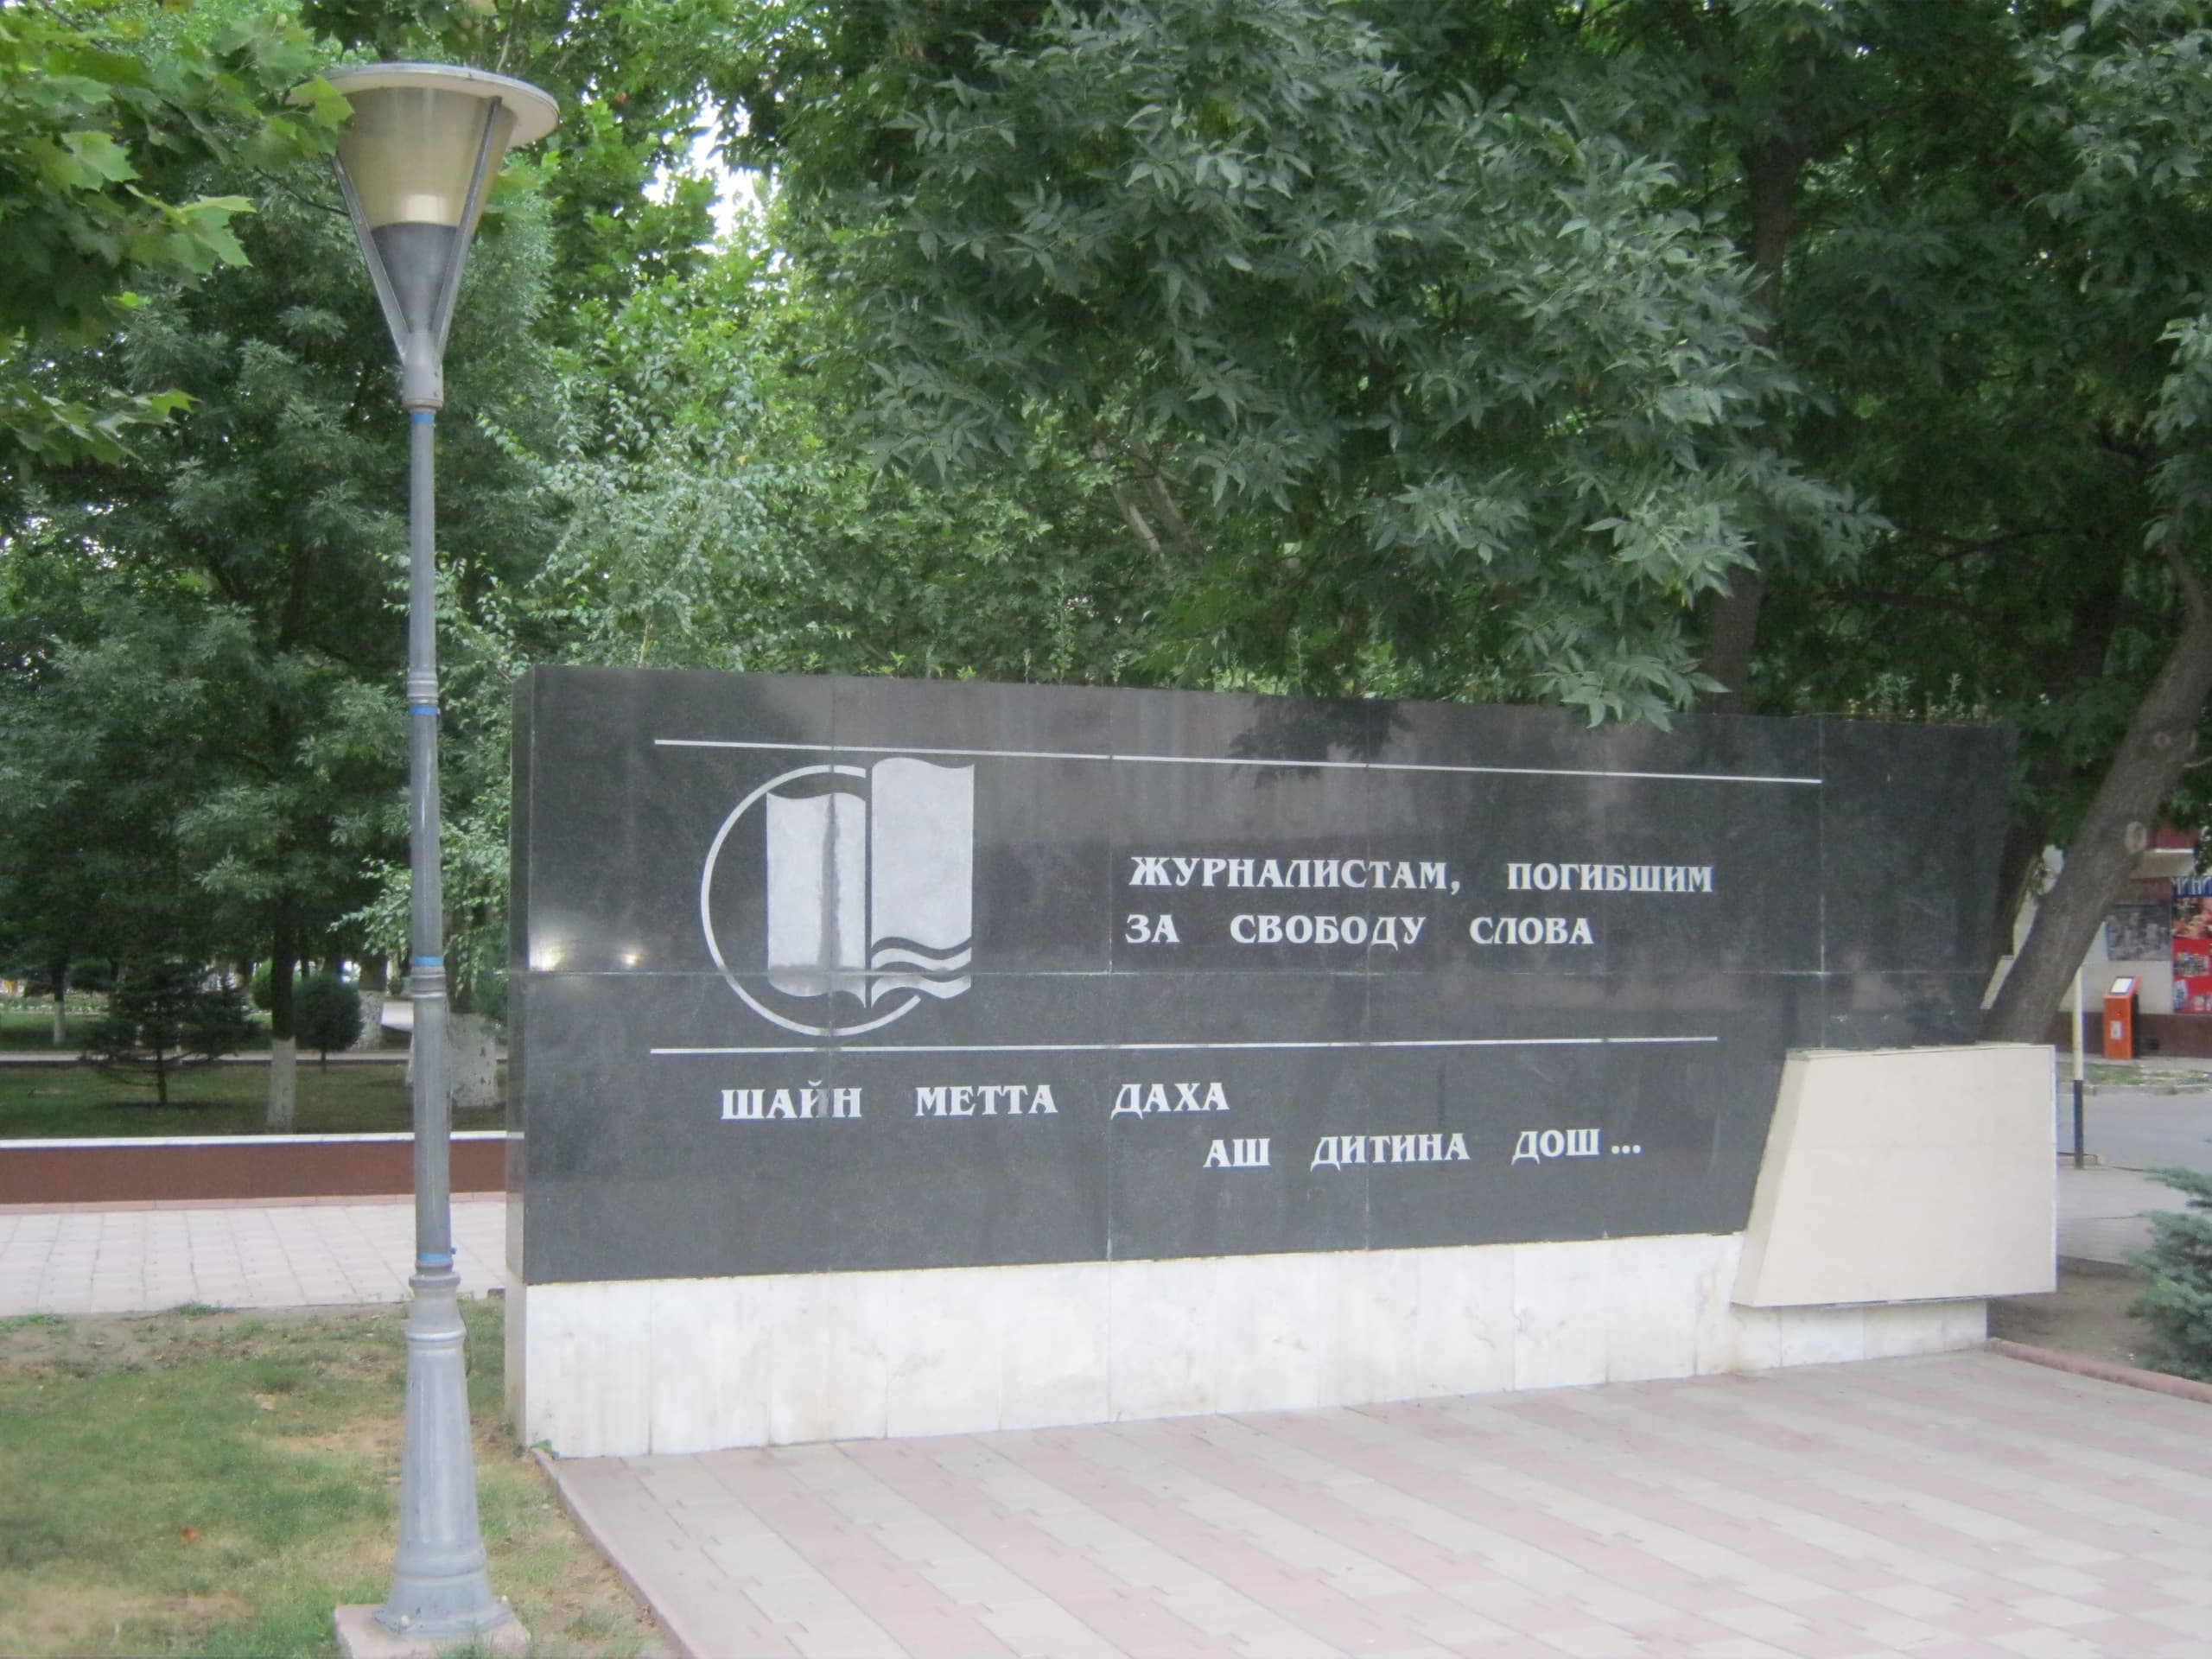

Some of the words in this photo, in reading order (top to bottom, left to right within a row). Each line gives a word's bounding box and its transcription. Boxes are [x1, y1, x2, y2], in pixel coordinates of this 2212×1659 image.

[1128, 856, 1461, 895] ЖУРНАЛИСТАМ,
[1506, 861, 1713, 893] ПОГИБШИМ
[1125, 913, 1181, 944] ЗА
[1230, 914, 1427, 950] СВОБОДУ
[1469, 916, 1595, 945] СЛОВА
[721, 1080, 863, 1120] ШАЙН
[915, 1084, 1059, 1116] МЕТТА
[1110, 1082, 1230, 1121] ДАХА
[1203, 1137, 1271, 1168] АШ
[1309, 1133, 1471, 1173] ДИТИНА
